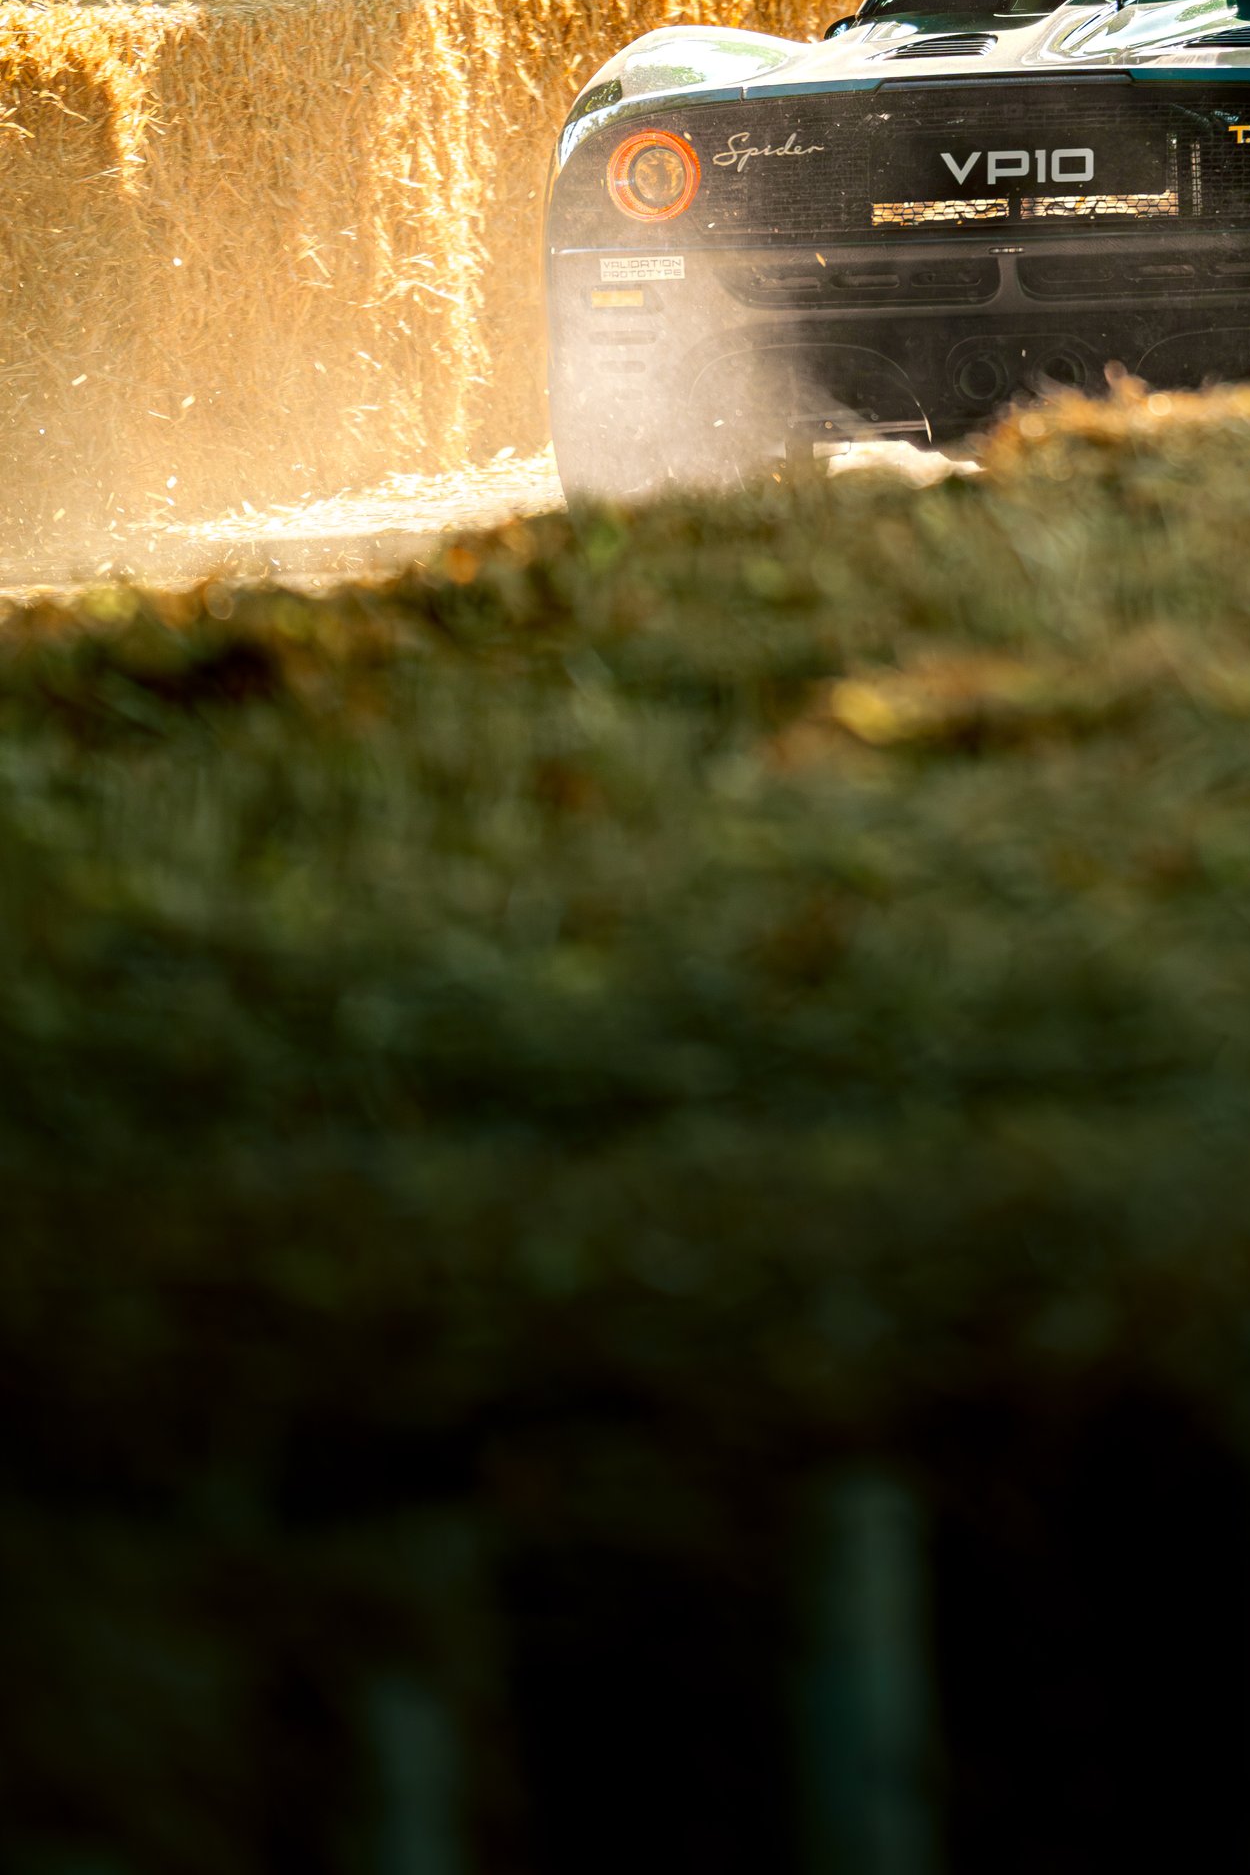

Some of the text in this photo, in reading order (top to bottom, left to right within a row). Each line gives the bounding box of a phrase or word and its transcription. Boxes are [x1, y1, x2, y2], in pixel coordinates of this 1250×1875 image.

[712, 131, 824, 172] Spider
[940, 147, 1095, 186] VP10
[602, 258, 681, 269] VALIDATION
[602, 268, 682, 278] PROTOTYPE
